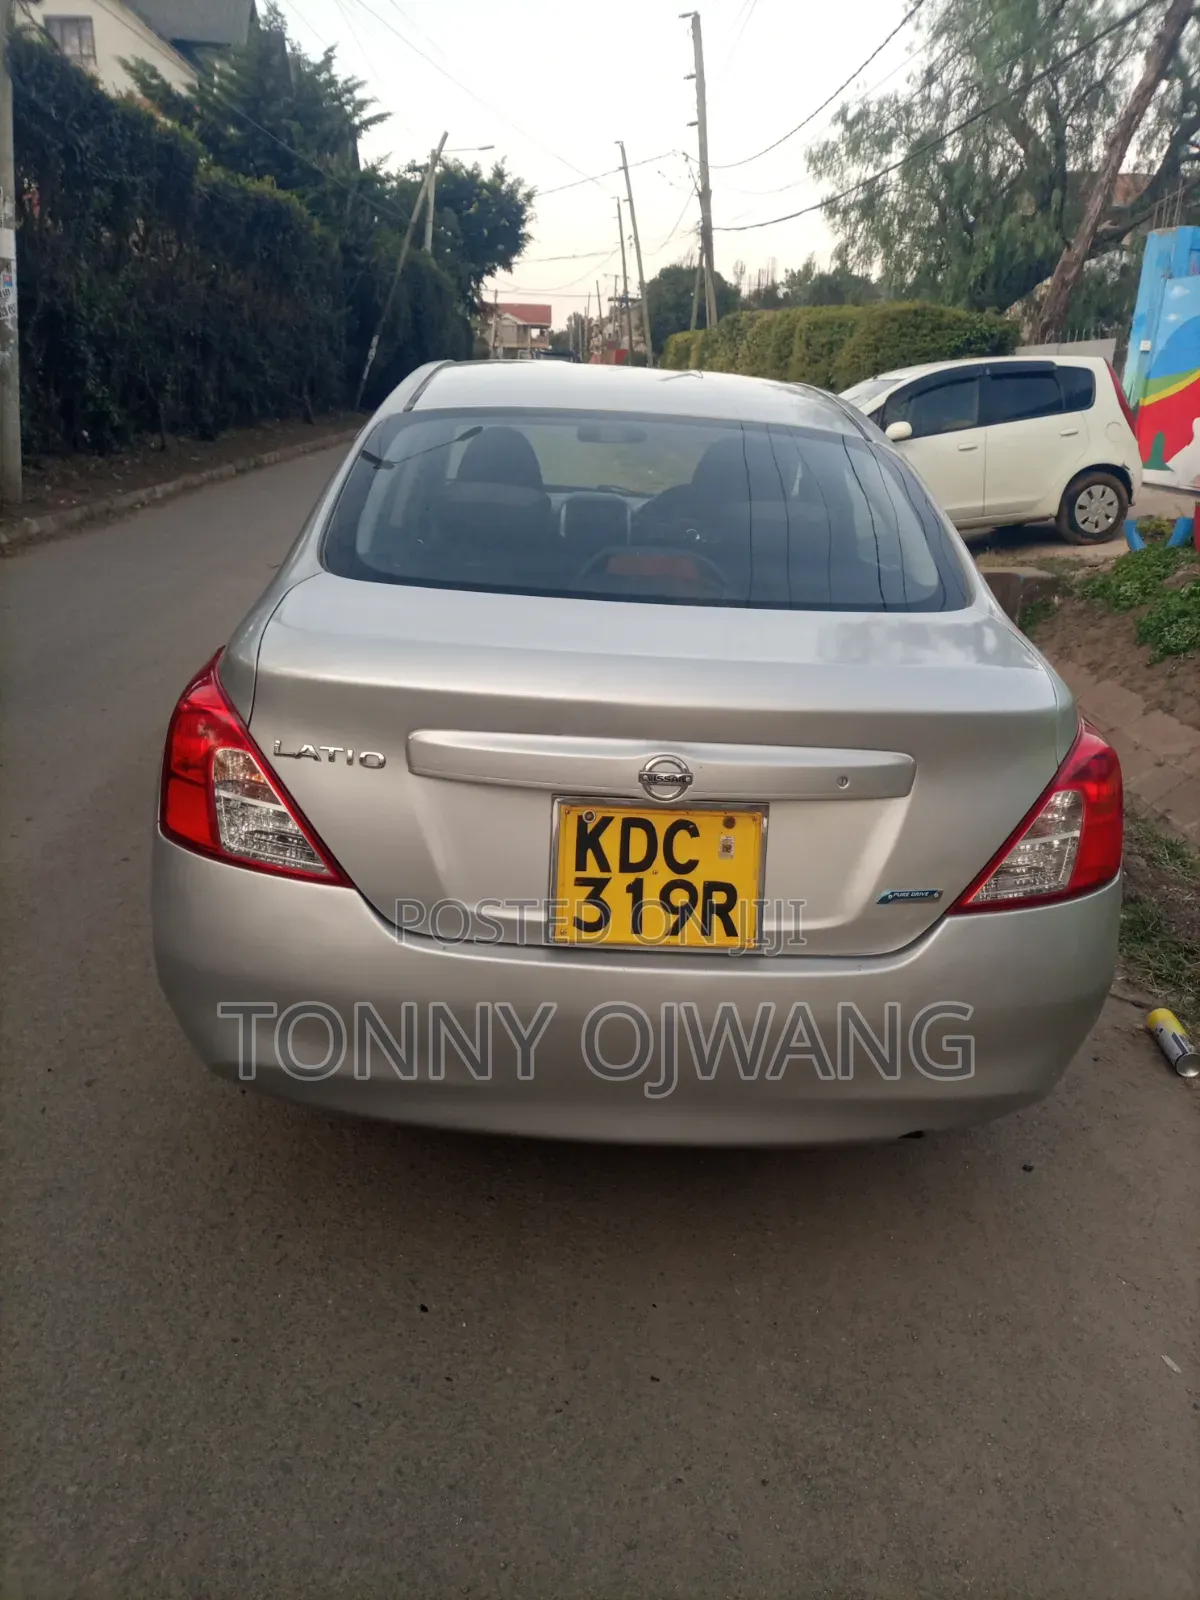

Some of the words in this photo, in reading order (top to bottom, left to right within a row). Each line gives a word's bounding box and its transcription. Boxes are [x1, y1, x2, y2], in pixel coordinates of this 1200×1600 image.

[273, 740, 387, 769] LATIO
[646, 774, 687, 783] NISSAN
[574, 814, 700, 875] KDC
[572, 876, 739, 938] 319R
